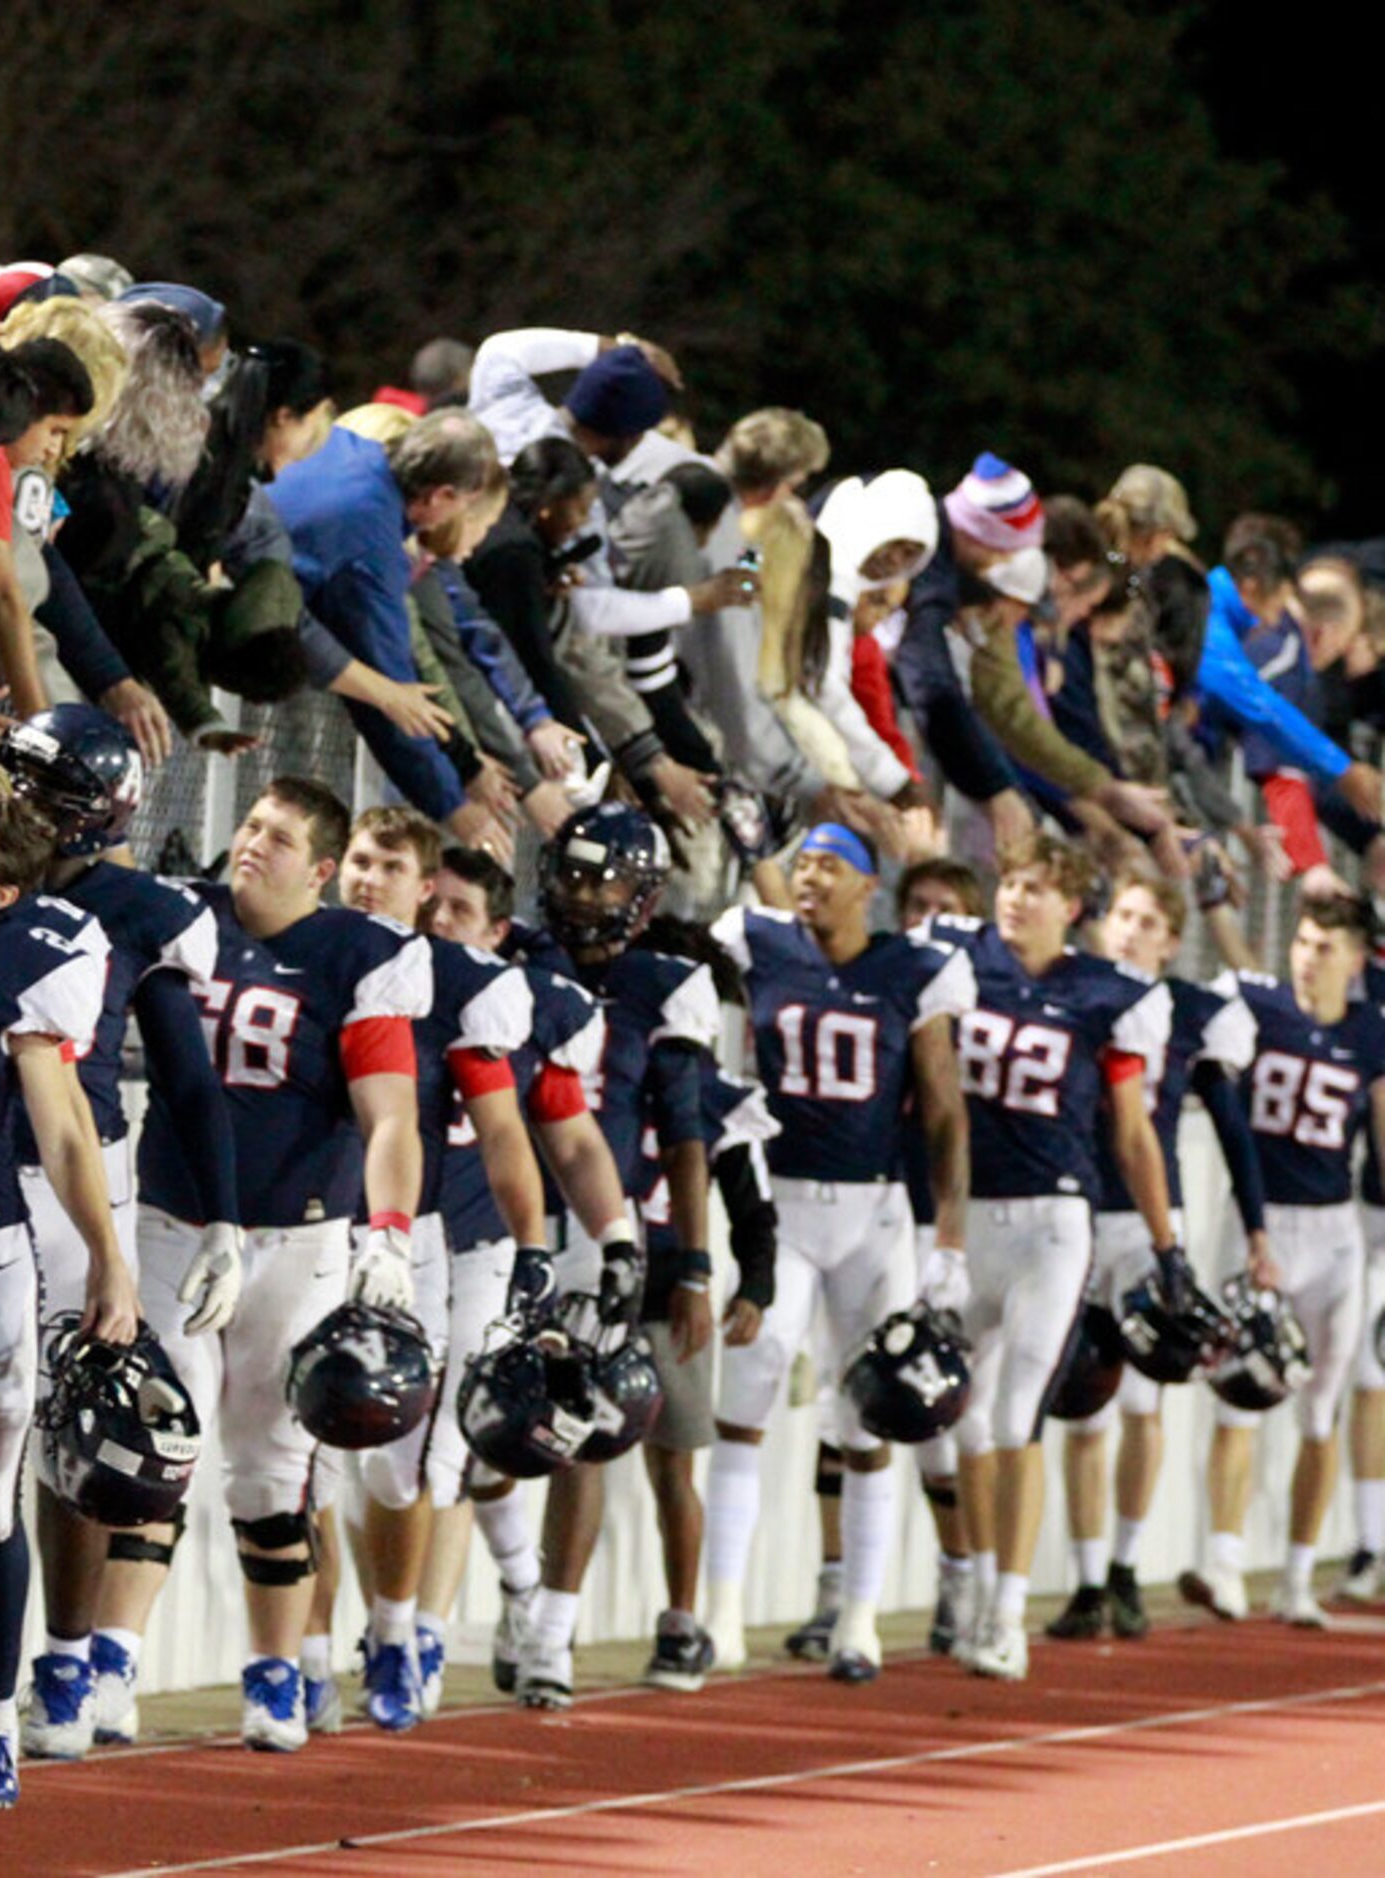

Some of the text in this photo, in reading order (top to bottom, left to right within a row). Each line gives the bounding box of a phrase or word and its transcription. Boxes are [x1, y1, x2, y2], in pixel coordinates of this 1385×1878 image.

[189, 975, 302, 1089] 8
[777, 1003, 878, 1102] 10
[957, 1008, 1071, 1117] 82
[1249, 1050, 1361, 1149] 85
[339, 1328, 388, 1375] A
